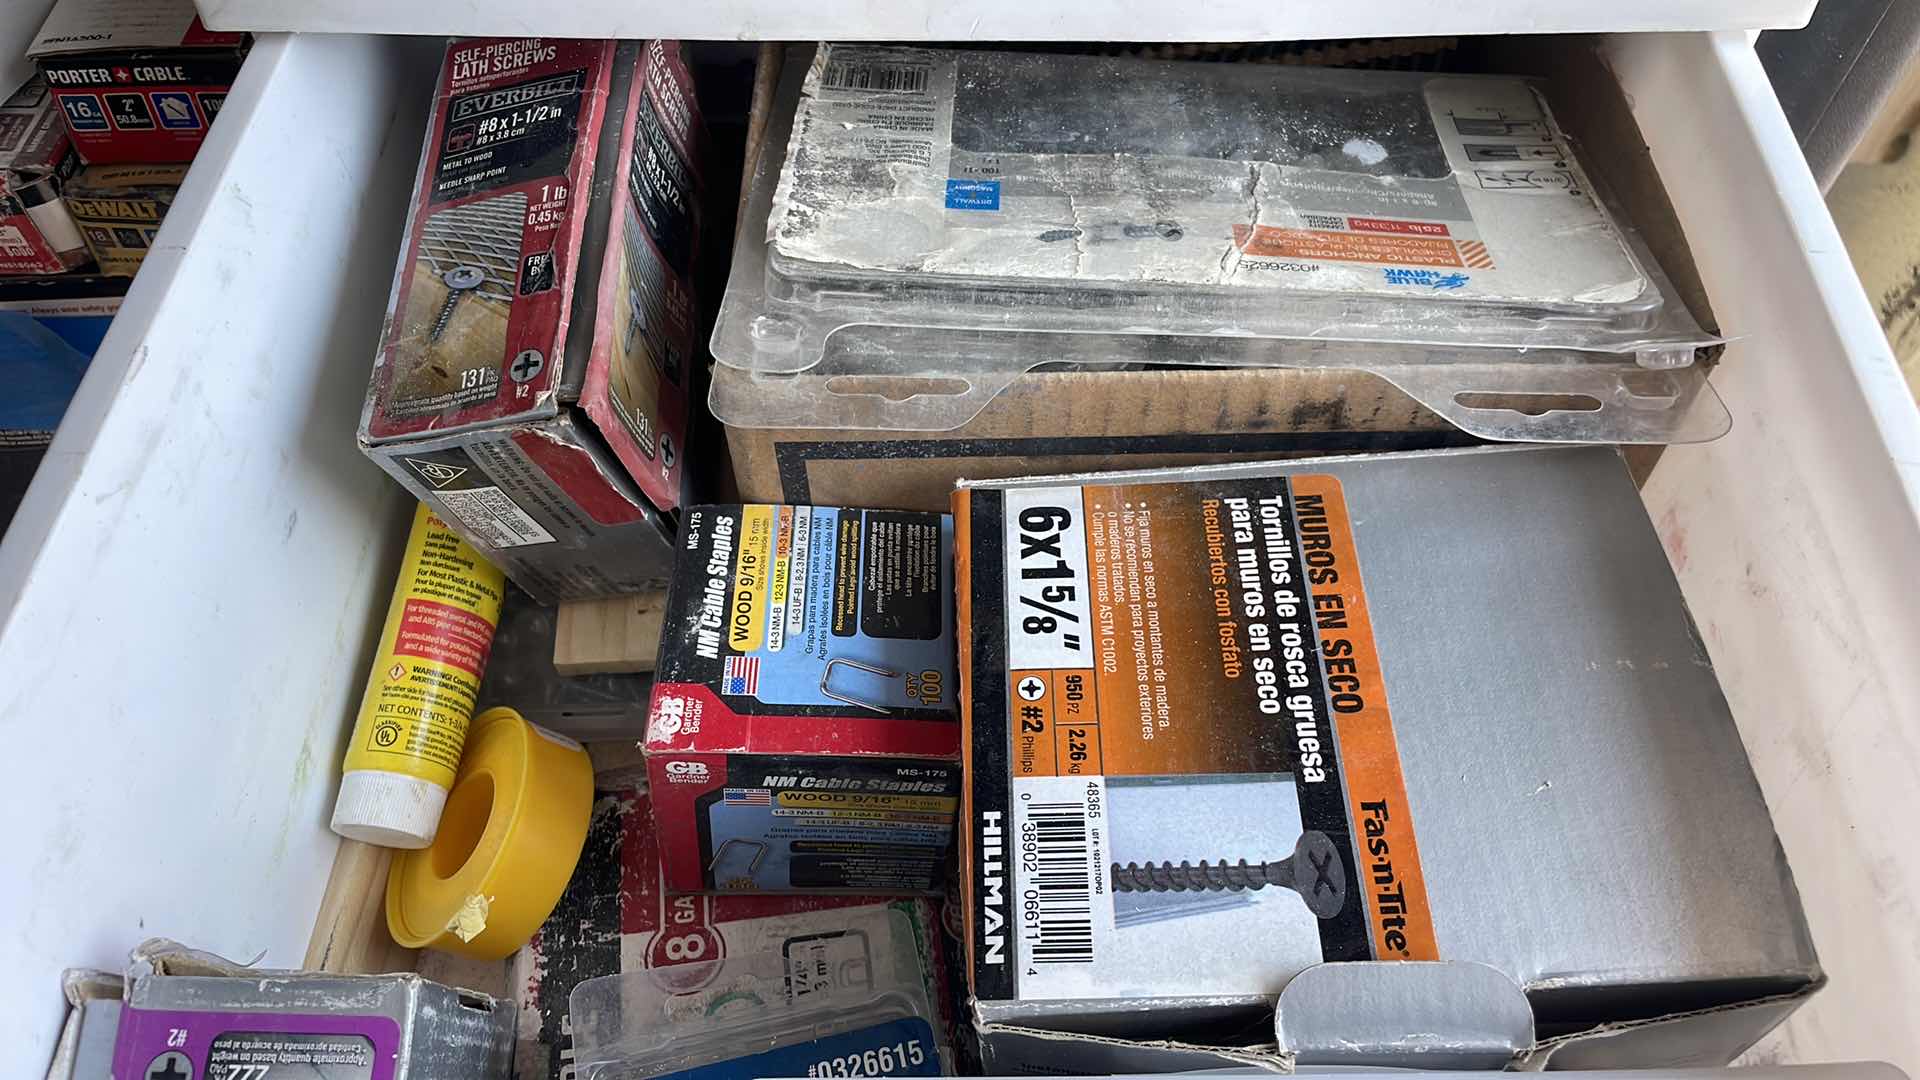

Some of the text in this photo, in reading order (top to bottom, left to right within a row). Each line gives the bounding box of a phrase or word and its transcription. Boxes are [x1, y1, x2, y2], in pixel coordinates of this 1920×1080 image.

[453, 46, 557, 80] LATH SCREWS
[454, 38, 542, 64] SELF-PIERCING
[46, 66, 187, 84] PORTER CABLE
[457, 78, 573, 117] EVERBILT
[478, 105, 562, 136] #8 x 1-1/2 in
[476, 127, 526, 146] #8 x 3.8 cm
[442, 158, 462, 171] METAL
[464, 156, 473, 164] TO
[474, 151, 493, 162] WOOD
[438, 178, 463, 191] NEEDLE
[464, 172, 485, 184] SHARP
[486, 166, 507, 178] POINT
[530, 199, 567, 213] NET WEIGHT
[542, 184, 568, 203] 1 lb
[68, 201, 158, 219] DEWALT
[1239, 259, 1321, 273] #0326625
[1298, 248, 1456, 265] PLASTIC ANCHORS
[1383, 267, 1441, 279] HAWK
[1386, 276, 1432, 288] BLUE
[461, 367, 486, 389] 131
[515, 384, 530, 399] #2
[687, 511, 702, 550] MS-175
[841, 520, 850, 542] damage
[1136, 510, 1151, 527] Fija
[427, 531, 460, 544] Lead Free
[870, 533, 878, 566] empotrable
[1108, 519, 1123, 561] maderos
[1140, 528, 1153, 559] muros
[422, 550, 475, 571] Non-Hardening
[739, 549, 757, 587] 9/16"
[839, 555, 847, 576] prevent
[1143, 561, 1154, 573] en
[696, 515, 734, 660] NM Cable Staples
[775, 560, 786, 601] 12-3 NM-B
[804, 517, 822, 655] Grapas para madera para cables NM
[868, 566, 876, 591] Cabezal
[1111, 562, 1127, 606] tratados.
[1145, 575, 1157, 599] seco
[1202, 499, 1240, 679] Recubiertos con fosfato
[838, 583, 846, 600] head
[1091, 511, 1118, 677] Cumple las normas ASTM C1002.
[734, 590, 753, 642] WOOD
[836, 600, 844, 631] Recessed
[1224, 497, 1281, 716] para muros en seco
[1294, 494, 1366, 715] MUROS EN SECO
[771, 607, 782, 650] 14-3 NM-B
[1123, 510, 1154, 740] No se recomiendan para proyectos exteriores
[1148, 610, 1165, 666] montantes
[1259, 495, 1327, 785] Tornillos de rosca gruesa
[724, 656, 732, 670] USA
[1153, 668, 1167, 682] de
[722, 677, 731, 695] MADE
[906, 671, 919, 700] QTY
[919, 670, 943, 706] 100
[1065, 674, 1084, 715] 950 PZ
[660, 696, 685, 735] GB
[680, 696, 694, 736] Gardner
[690, 698, 703, 734] Bender
[1155, 685, 1171, 731] madera.
[1019, 705, 1045, 774] #2 Phillips
[1067, 729, 1088, 775] 2.26 kg
[665, 761, 710, 775] GB
[665, 772, 711, 781] Gardner
[896, 767, 948, 778] MS-175
[669, 777, 710, 785] Bender
[762, 774, 948, 793] NM Cable Staples
[1086, 781, 1101, 819] 48365
[1091, 828, 1100, 840] LOT
[982, 810, 1005, 966] HILLMAN
[1020, 793, 1041, 977] 0 38902 06611 4
[167, 1028, 188, 1047] #2
[212, 1051, 238, 1062] weight
[238, 1053, 251, 1061] on
[252, 1053, 278, 1063] based
[278, 1055, 311, 1064] quantity
[808, 1039, 924, 1078] #0326615
